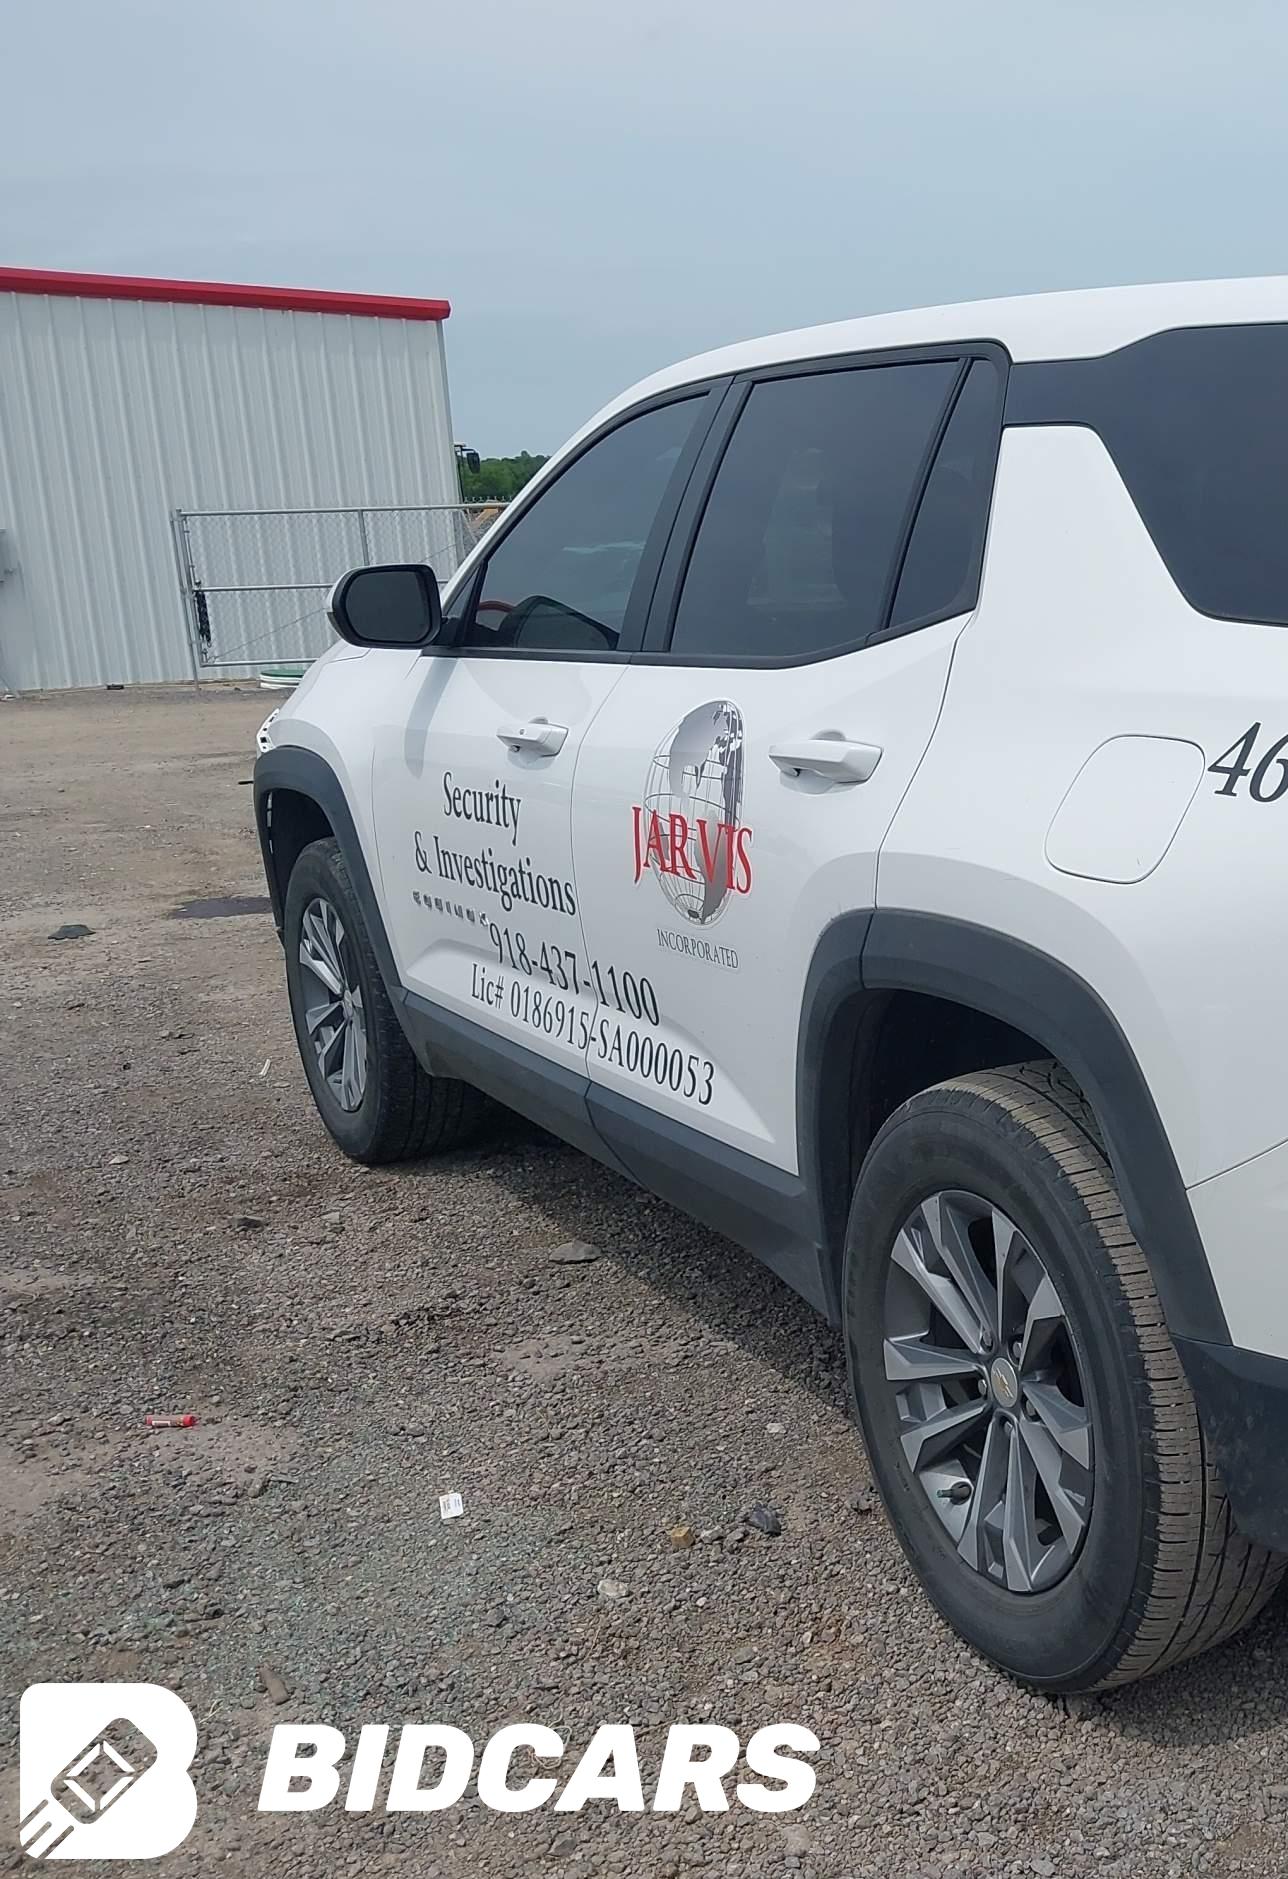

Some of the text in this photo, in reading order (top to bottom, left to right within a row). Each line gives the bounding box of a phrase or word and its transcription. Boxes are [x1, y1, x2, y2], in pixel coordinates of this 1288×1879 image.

[443, 771, 521, 845] Security
[631, 805, 753, 894] JARVIS
[413, 831, 432, 875] &
[432, 835, 576, 916] Investigations
[489, 922, 660, 1027] 918-437-1100
[656, 928, 739, 970] INCORPORATED
[471, 963, 714, 1106] Lic# 0186915-SA000053
